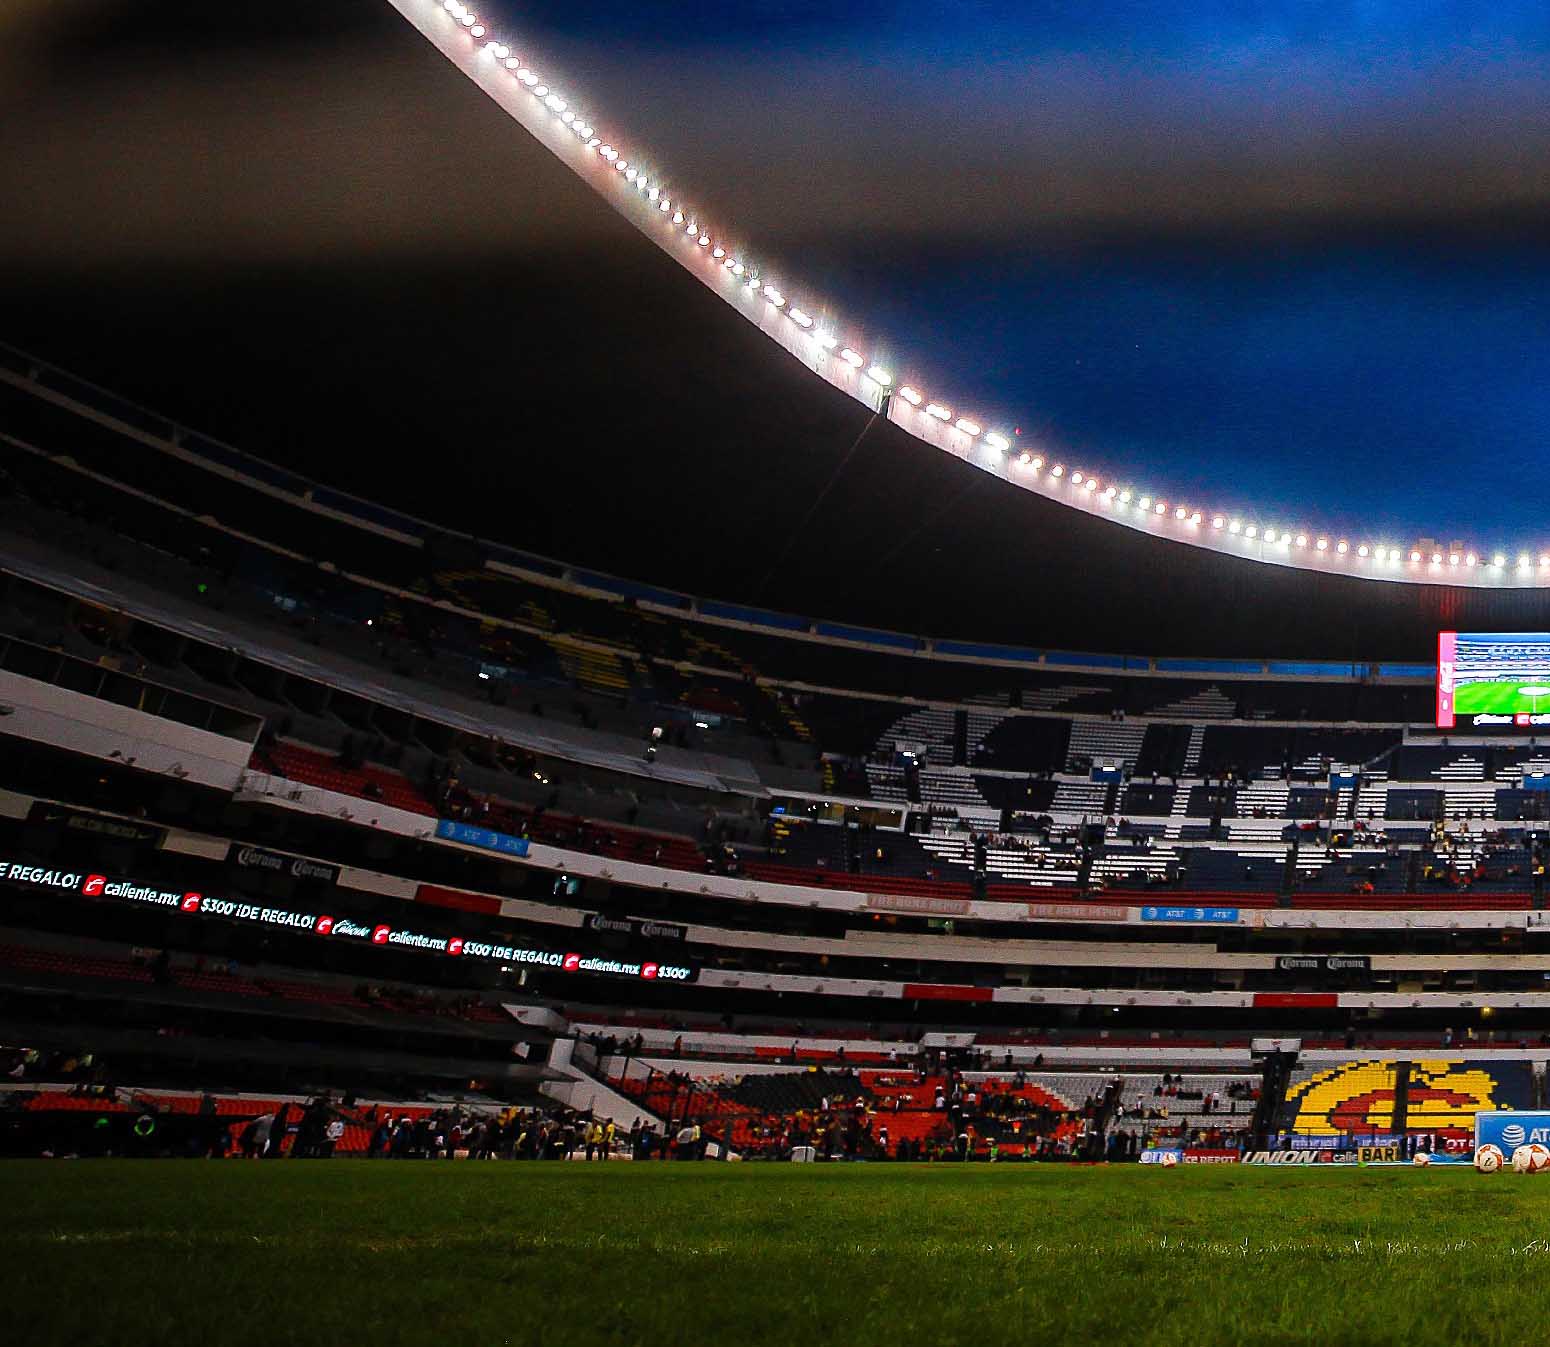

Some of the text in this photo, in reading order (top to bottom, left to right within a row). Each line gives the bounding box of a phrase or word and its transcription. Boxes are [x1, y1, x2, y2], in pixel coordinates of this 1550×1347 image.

[9, 864, 82, 889] REGALO!
[104, 882, 179, 907] caliente.mx
[260, 908, 317, 929] REGALO!
[388, 929, 448, 951] caliente.mx
[511, 948, 563, 967] REGALO!
[578, 957, 641, 975] caliente.mx
[589, 913, 681, 938] Corona Corona
[1279, 957, 1365, 969] Corona Corona
[1200, 1156, 1236, 1164] DEPOT
[1241, 1150, 1318, 1164] UNION
[1361, 1148, 1395, 1162] BAR
